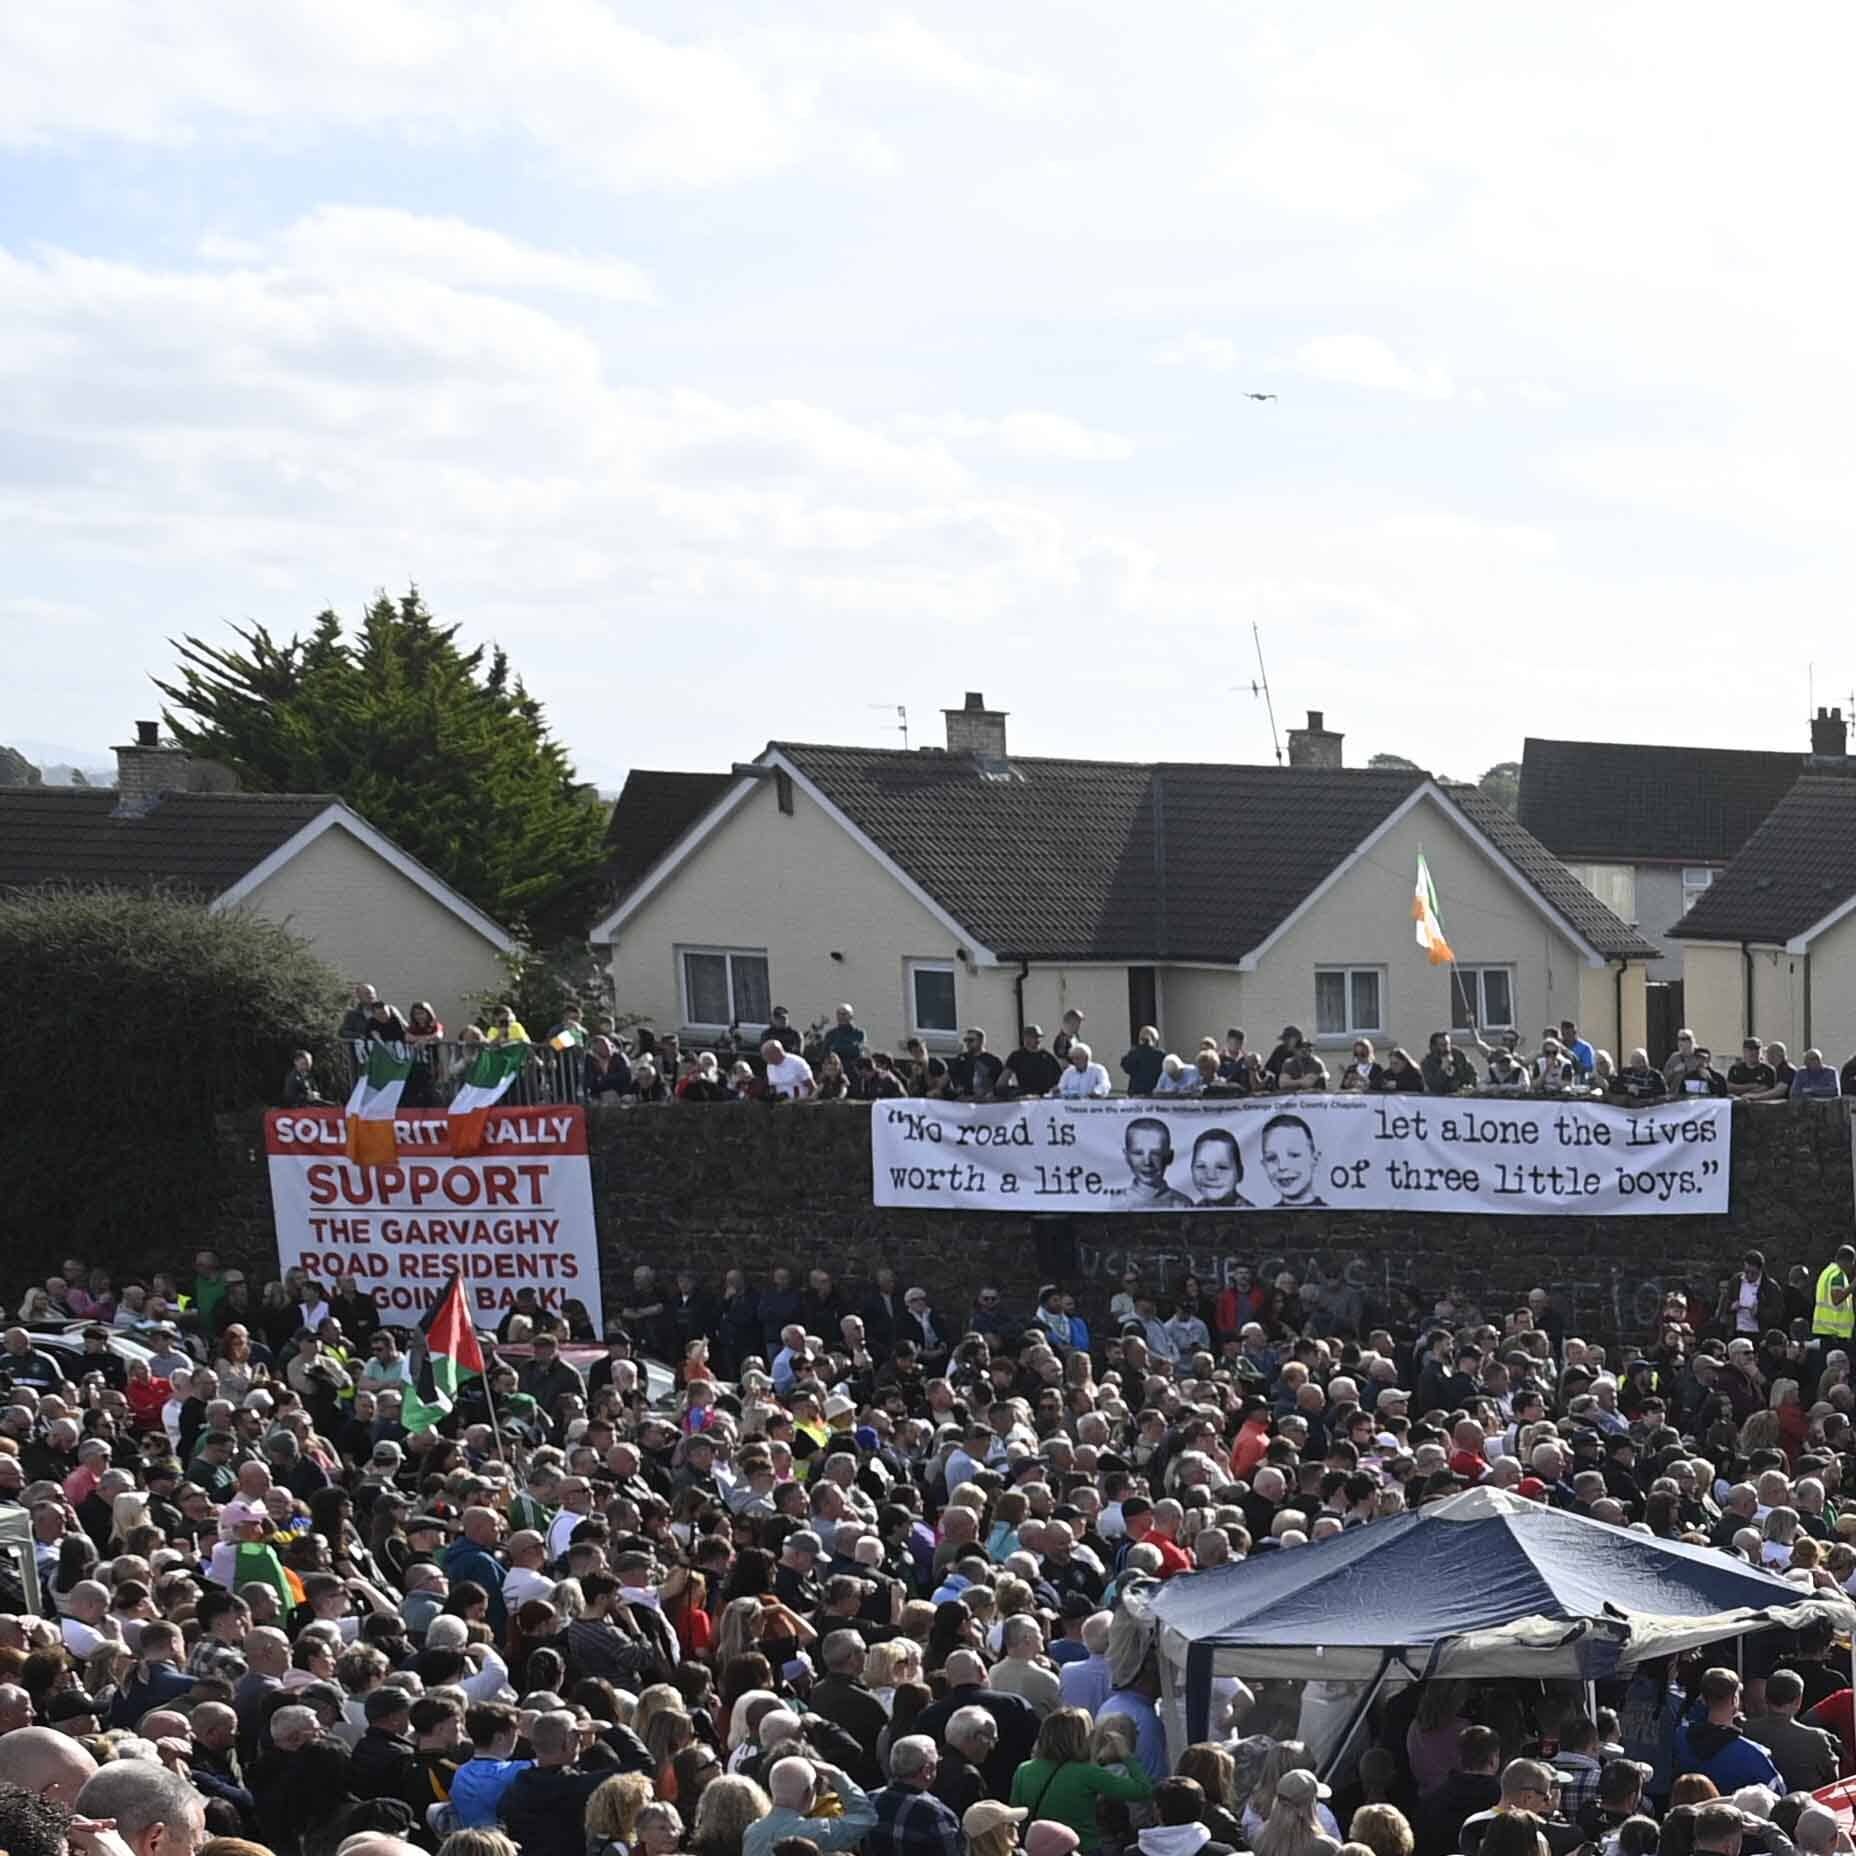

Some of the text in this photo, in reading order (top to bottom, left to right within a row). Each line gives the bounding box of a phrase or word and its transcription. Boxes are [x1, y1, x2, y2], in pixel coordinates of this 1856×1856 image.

[276, 1117, 448, 1144] SOLIRIT
[955, 1118, 1033, 1146] road
[1047, 1118, 1075, 1146] is
[1374, 1110, 1717, 1147] let alone the lives
[307, 1164, 550, 1205] SUPPORT
[889, 1164, 986, 1193] worth
[1000, 1172, 1018, 1195] a
[1330, 1160, 1370, 1189] of
[1386, 1160, 1480, 1191] three
[1494, 1164, 1600, 1195] little
[308, 1219, 560, 1245] THE GARVAGHY
[300, 1252, 578, 1279] ROAD RESIDENTS
[375, 1287, 441, 1310] GOIN
